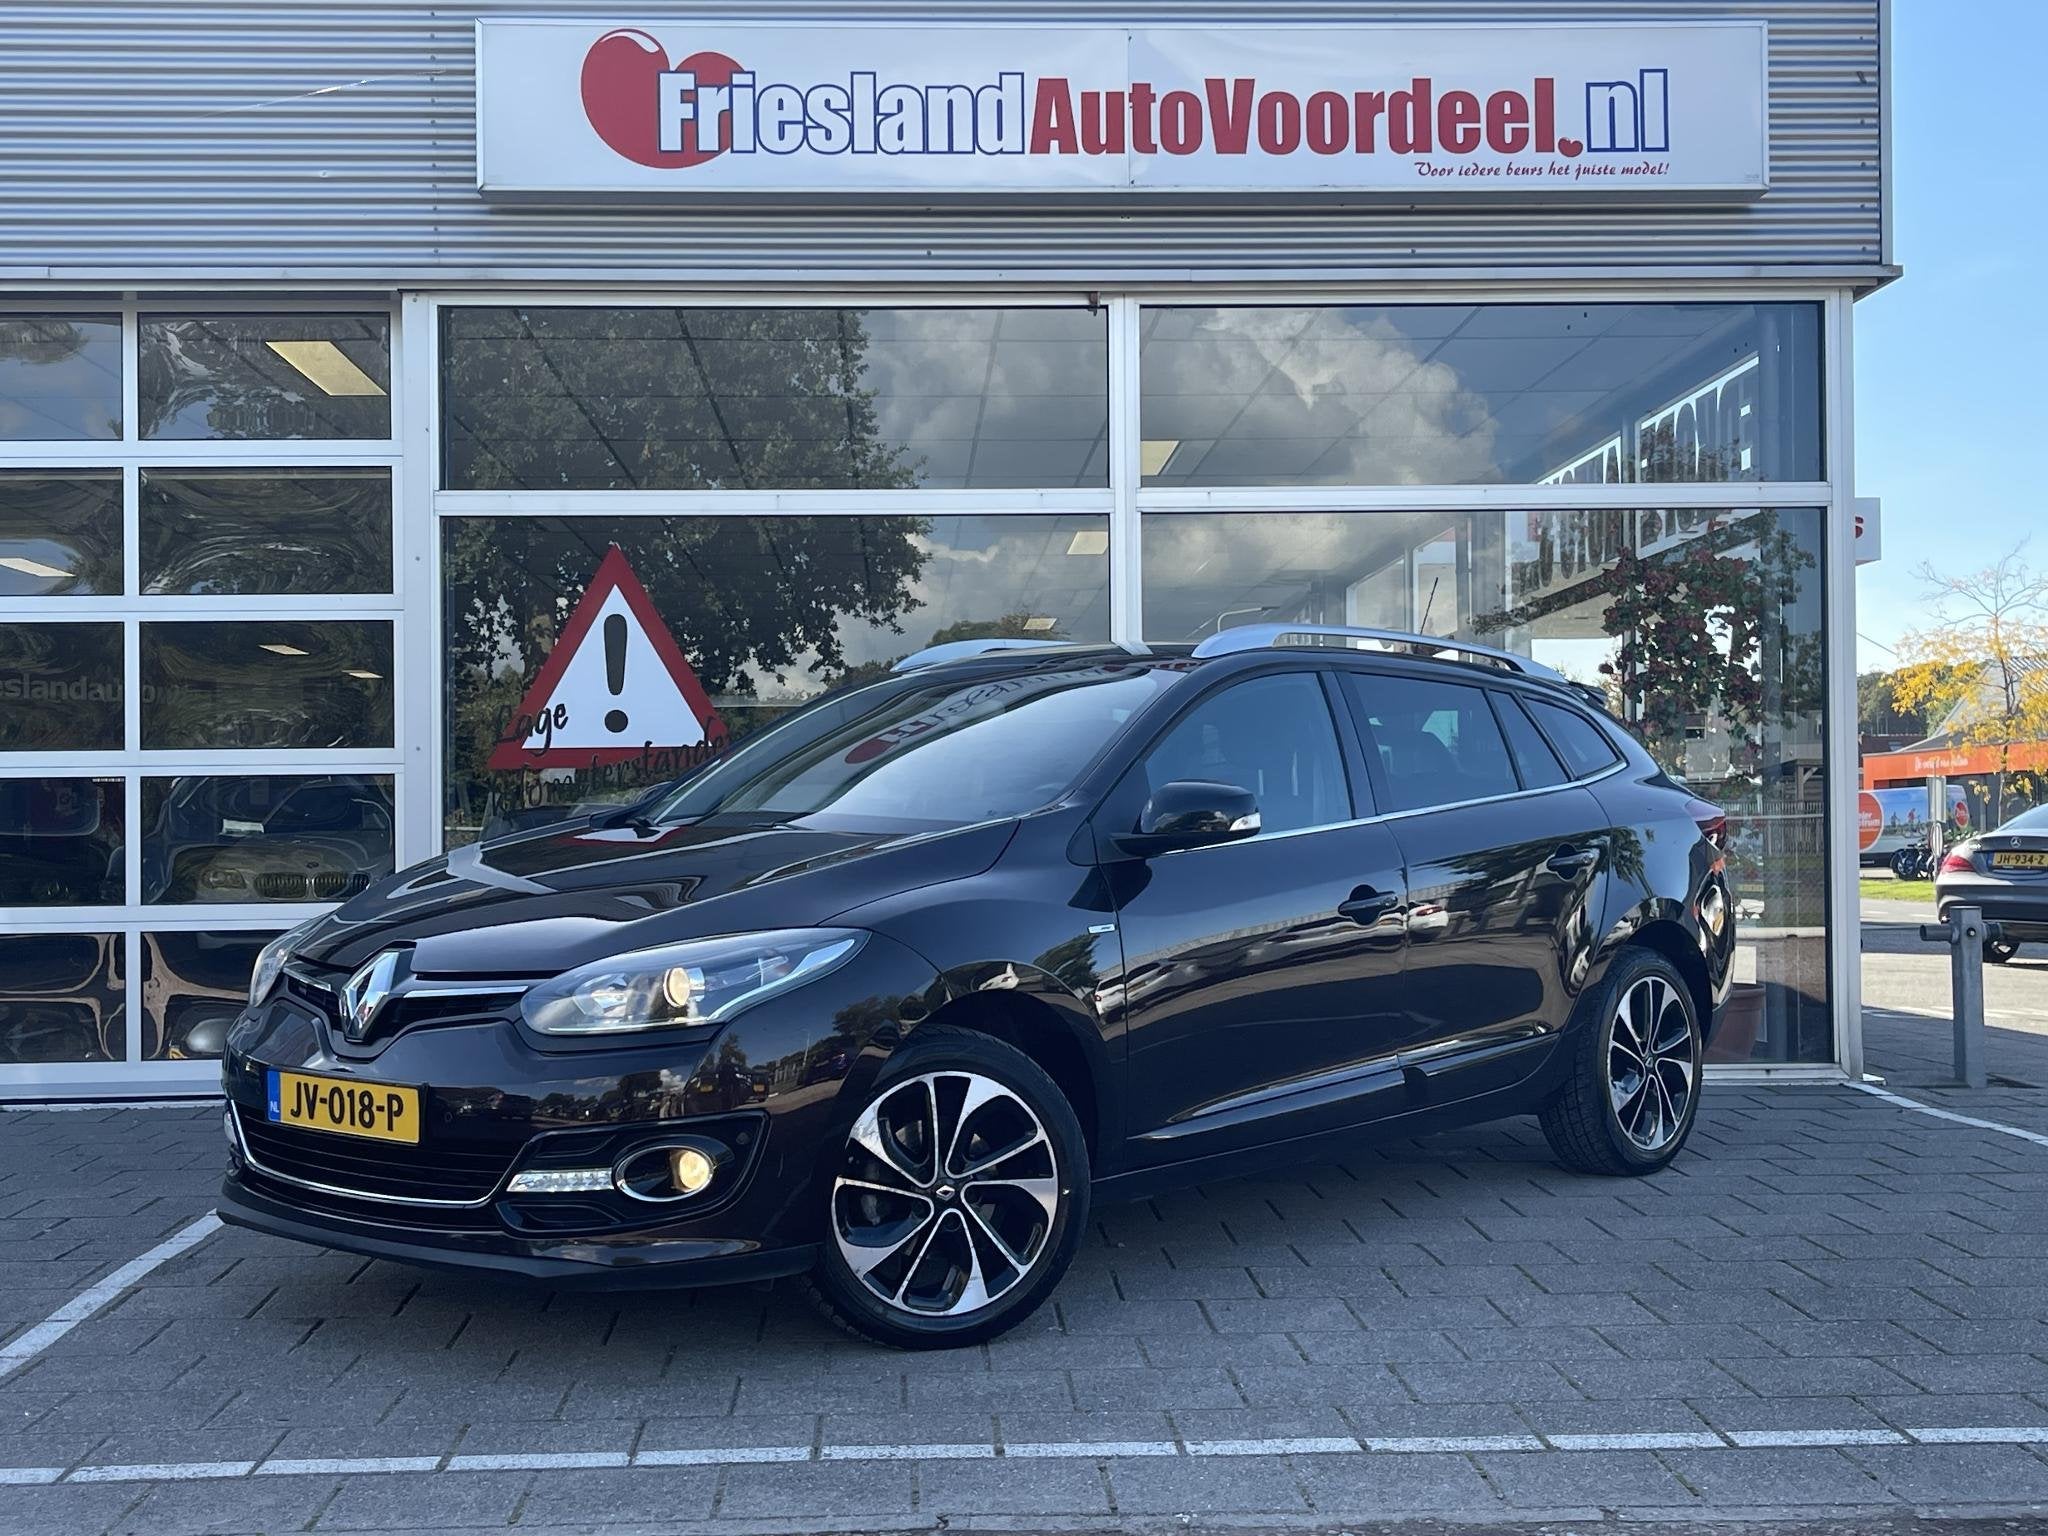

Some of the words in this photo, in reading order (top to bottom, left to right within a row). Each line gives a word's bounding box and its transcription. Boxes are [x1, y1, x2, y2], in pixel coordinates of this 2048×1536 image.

[1414, 161, 1454, 177] Voor
[1458, 162, 1501, 177] iedere
[1506, 161, 1544, 176] beurs
[1548, 161, 1570, 176] het
[1574, 161, 1617, 181] juiste
[1620, 161, 1670, 176] model!
[1996, 854, 2045, 865] JH-934-Z
[270, 1101, 280, 1113] NL
[290, 1081, 404, 1132] JV-018-P
